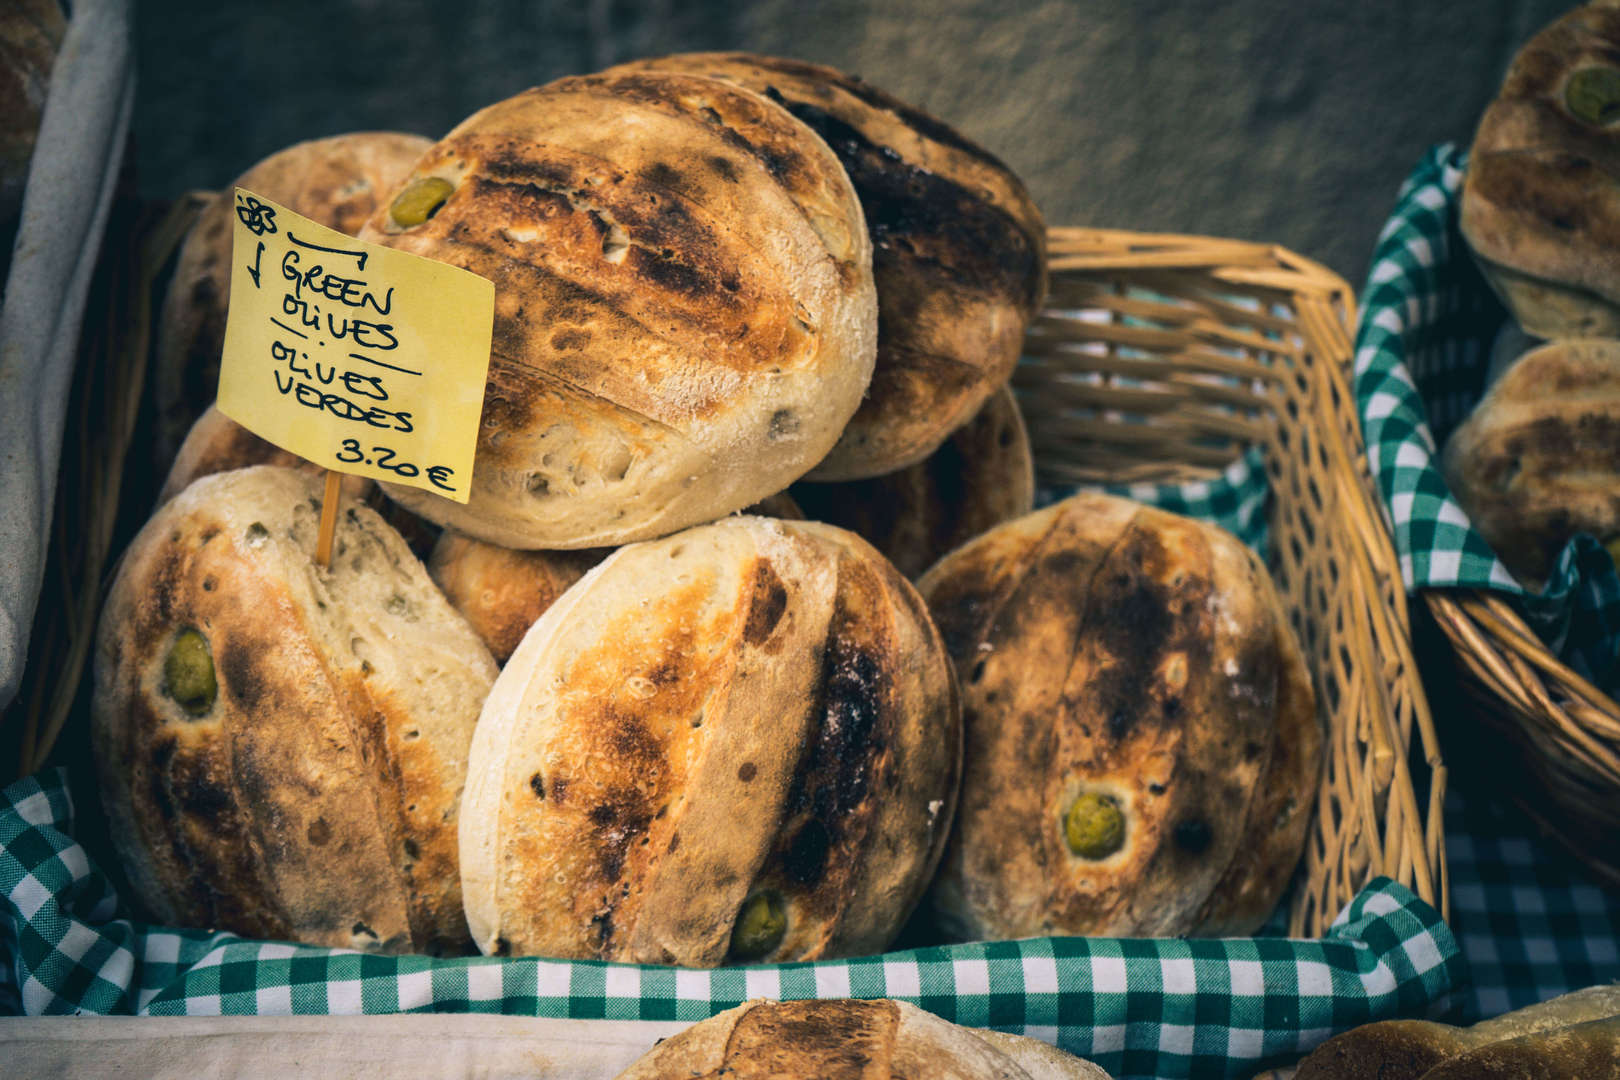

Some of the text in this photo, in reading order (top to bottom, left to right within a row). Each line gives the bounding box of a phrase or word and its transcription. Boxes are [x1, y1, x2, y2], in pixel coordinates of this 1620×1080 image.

[282, 250, 394, 316] GREEN
[274, 369, 413, 433] VERDES
[336, 438, 456, 492] 3.20€
